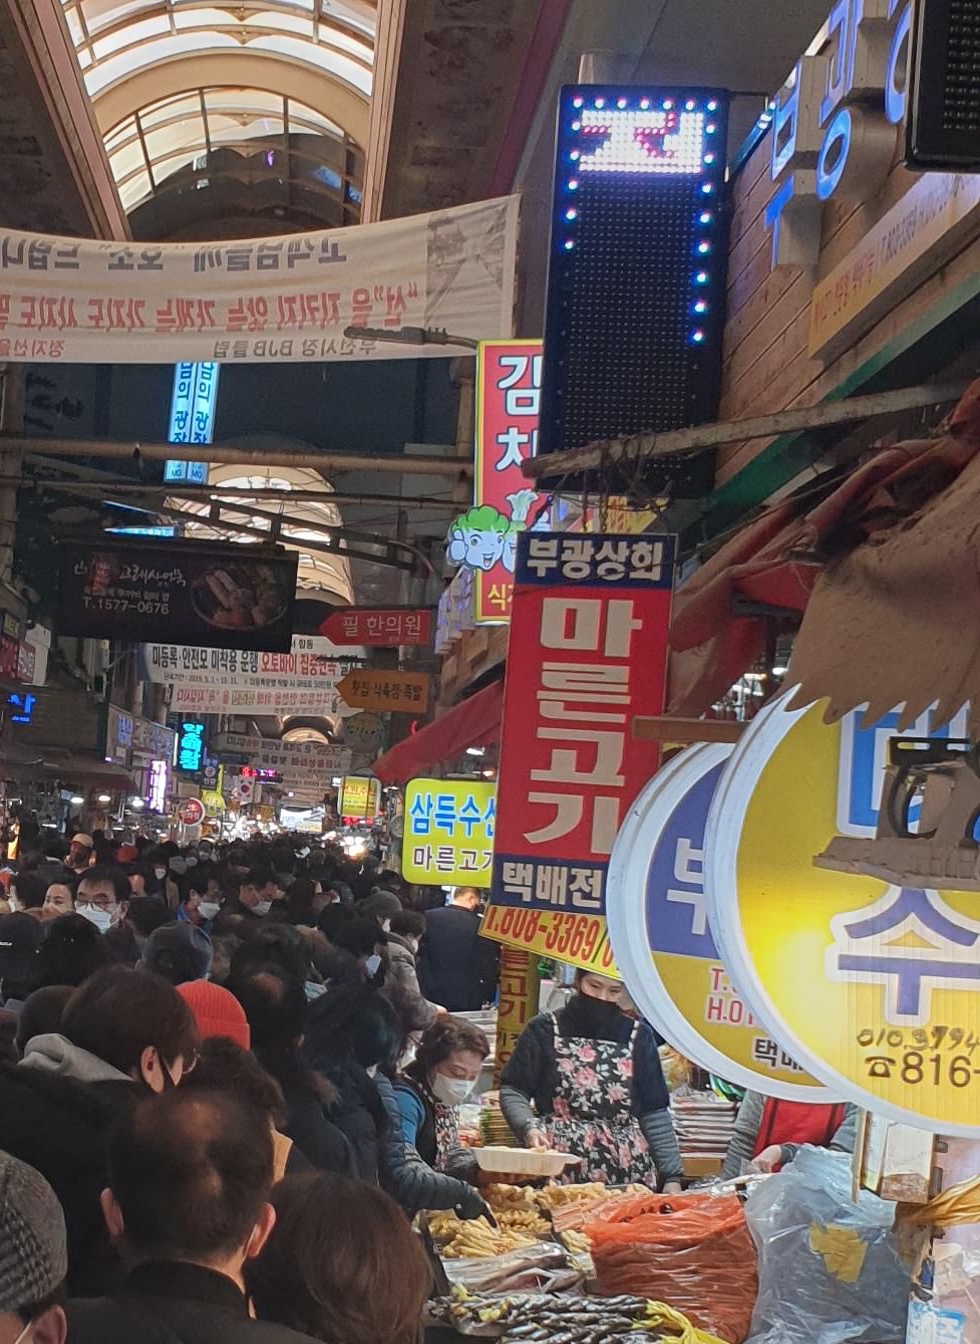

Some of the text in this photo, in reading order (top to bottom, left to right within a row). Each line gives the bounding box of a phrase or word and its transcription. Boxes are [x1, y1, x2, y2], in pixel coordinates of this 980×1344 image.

[526, 536, 663, 582] 부광상회
[343, 614, 421, 637] 필 한의원
[260, 653, 298, 675] 오토바이
[523, 597, 643, 856] 마른고기
